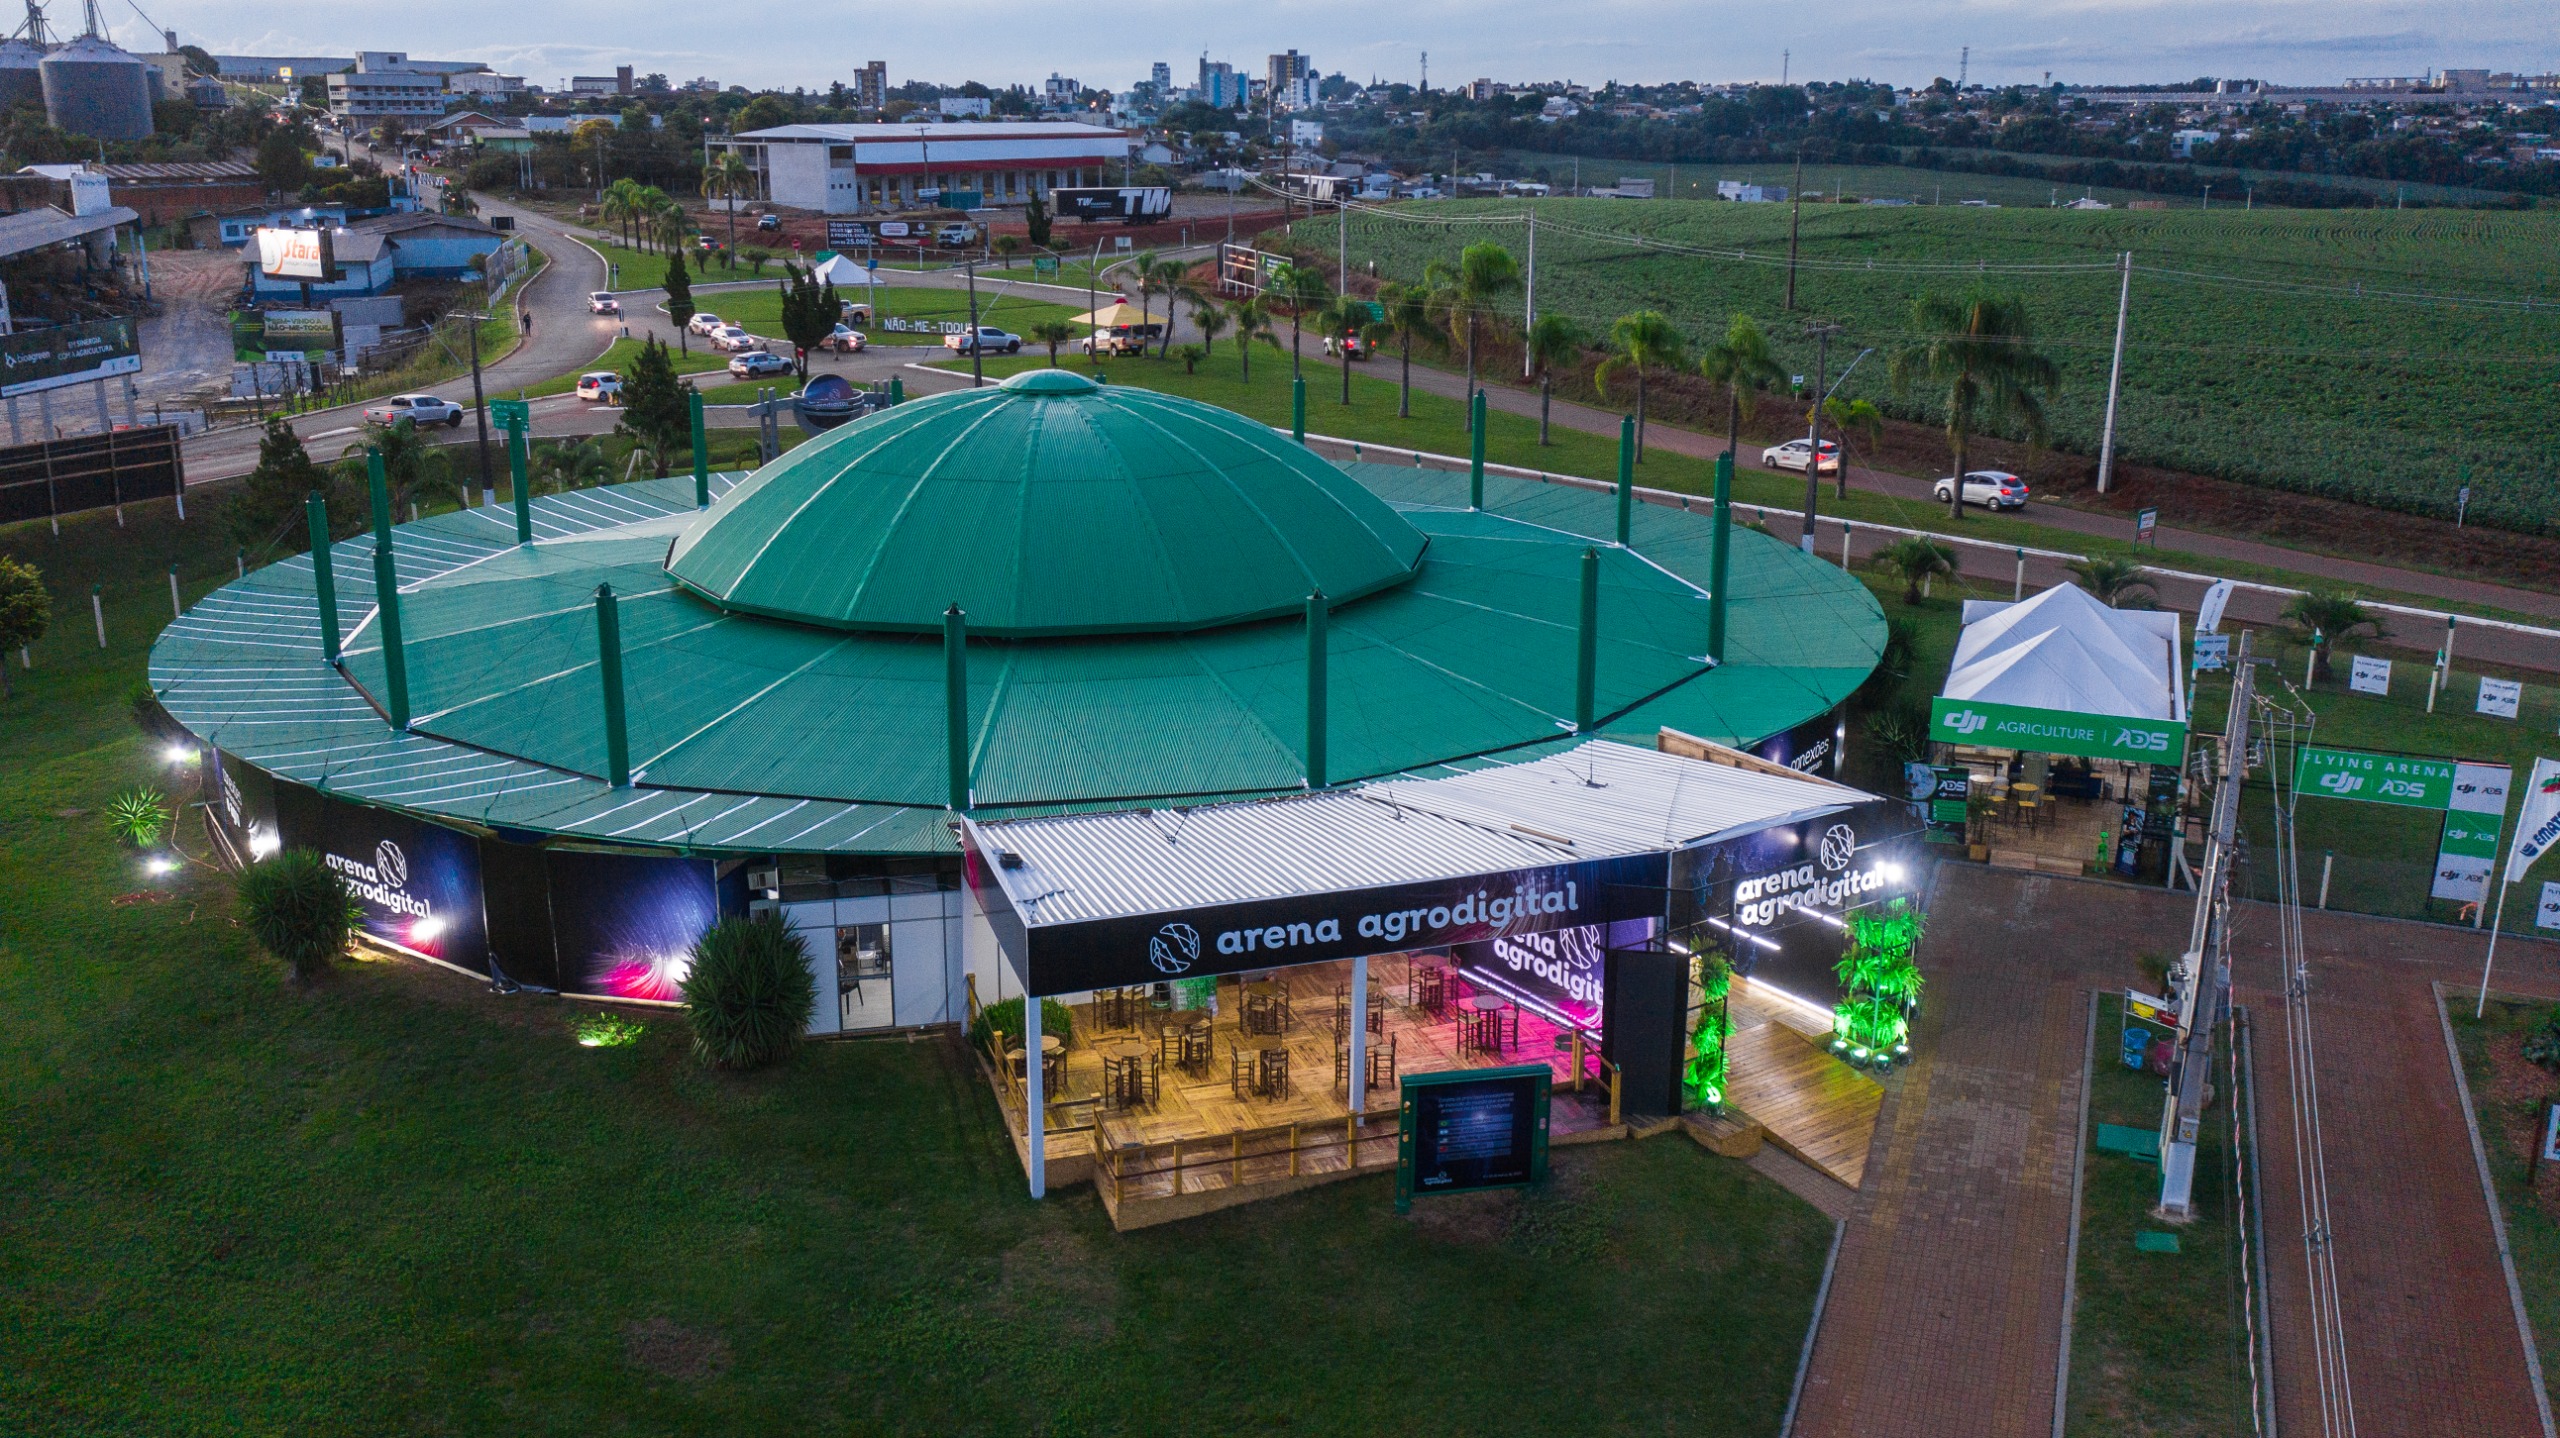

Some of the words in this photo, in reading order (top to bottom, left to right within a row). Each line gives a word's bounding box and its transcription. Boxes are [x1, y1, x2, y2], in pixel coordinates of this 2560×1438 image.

[284, 240, 320, 260] Stara
[1996, 721, 2095, 742] AGRICULTURE
[2112, 727, 2170, 751] ADS
[2303, 752, 2374, 771] FLYING
[2384, 762, 2451, 779] ARENA
[1938, 779, 1968, 793] ADS
[2378, 778, 2427, 799] ADS
[2533, 809, 2560, 847] EMAT
[325, 853, 378, 883] arena
[1737, 865, 1816, 901] arena
[1741, 861, 1886, 926] agrodigital
[1217, 919, 1342, 955] arena
[1358, 881, 1579, 943] agrodigital
[1494, 939, 1604, 1011] agrodigit
